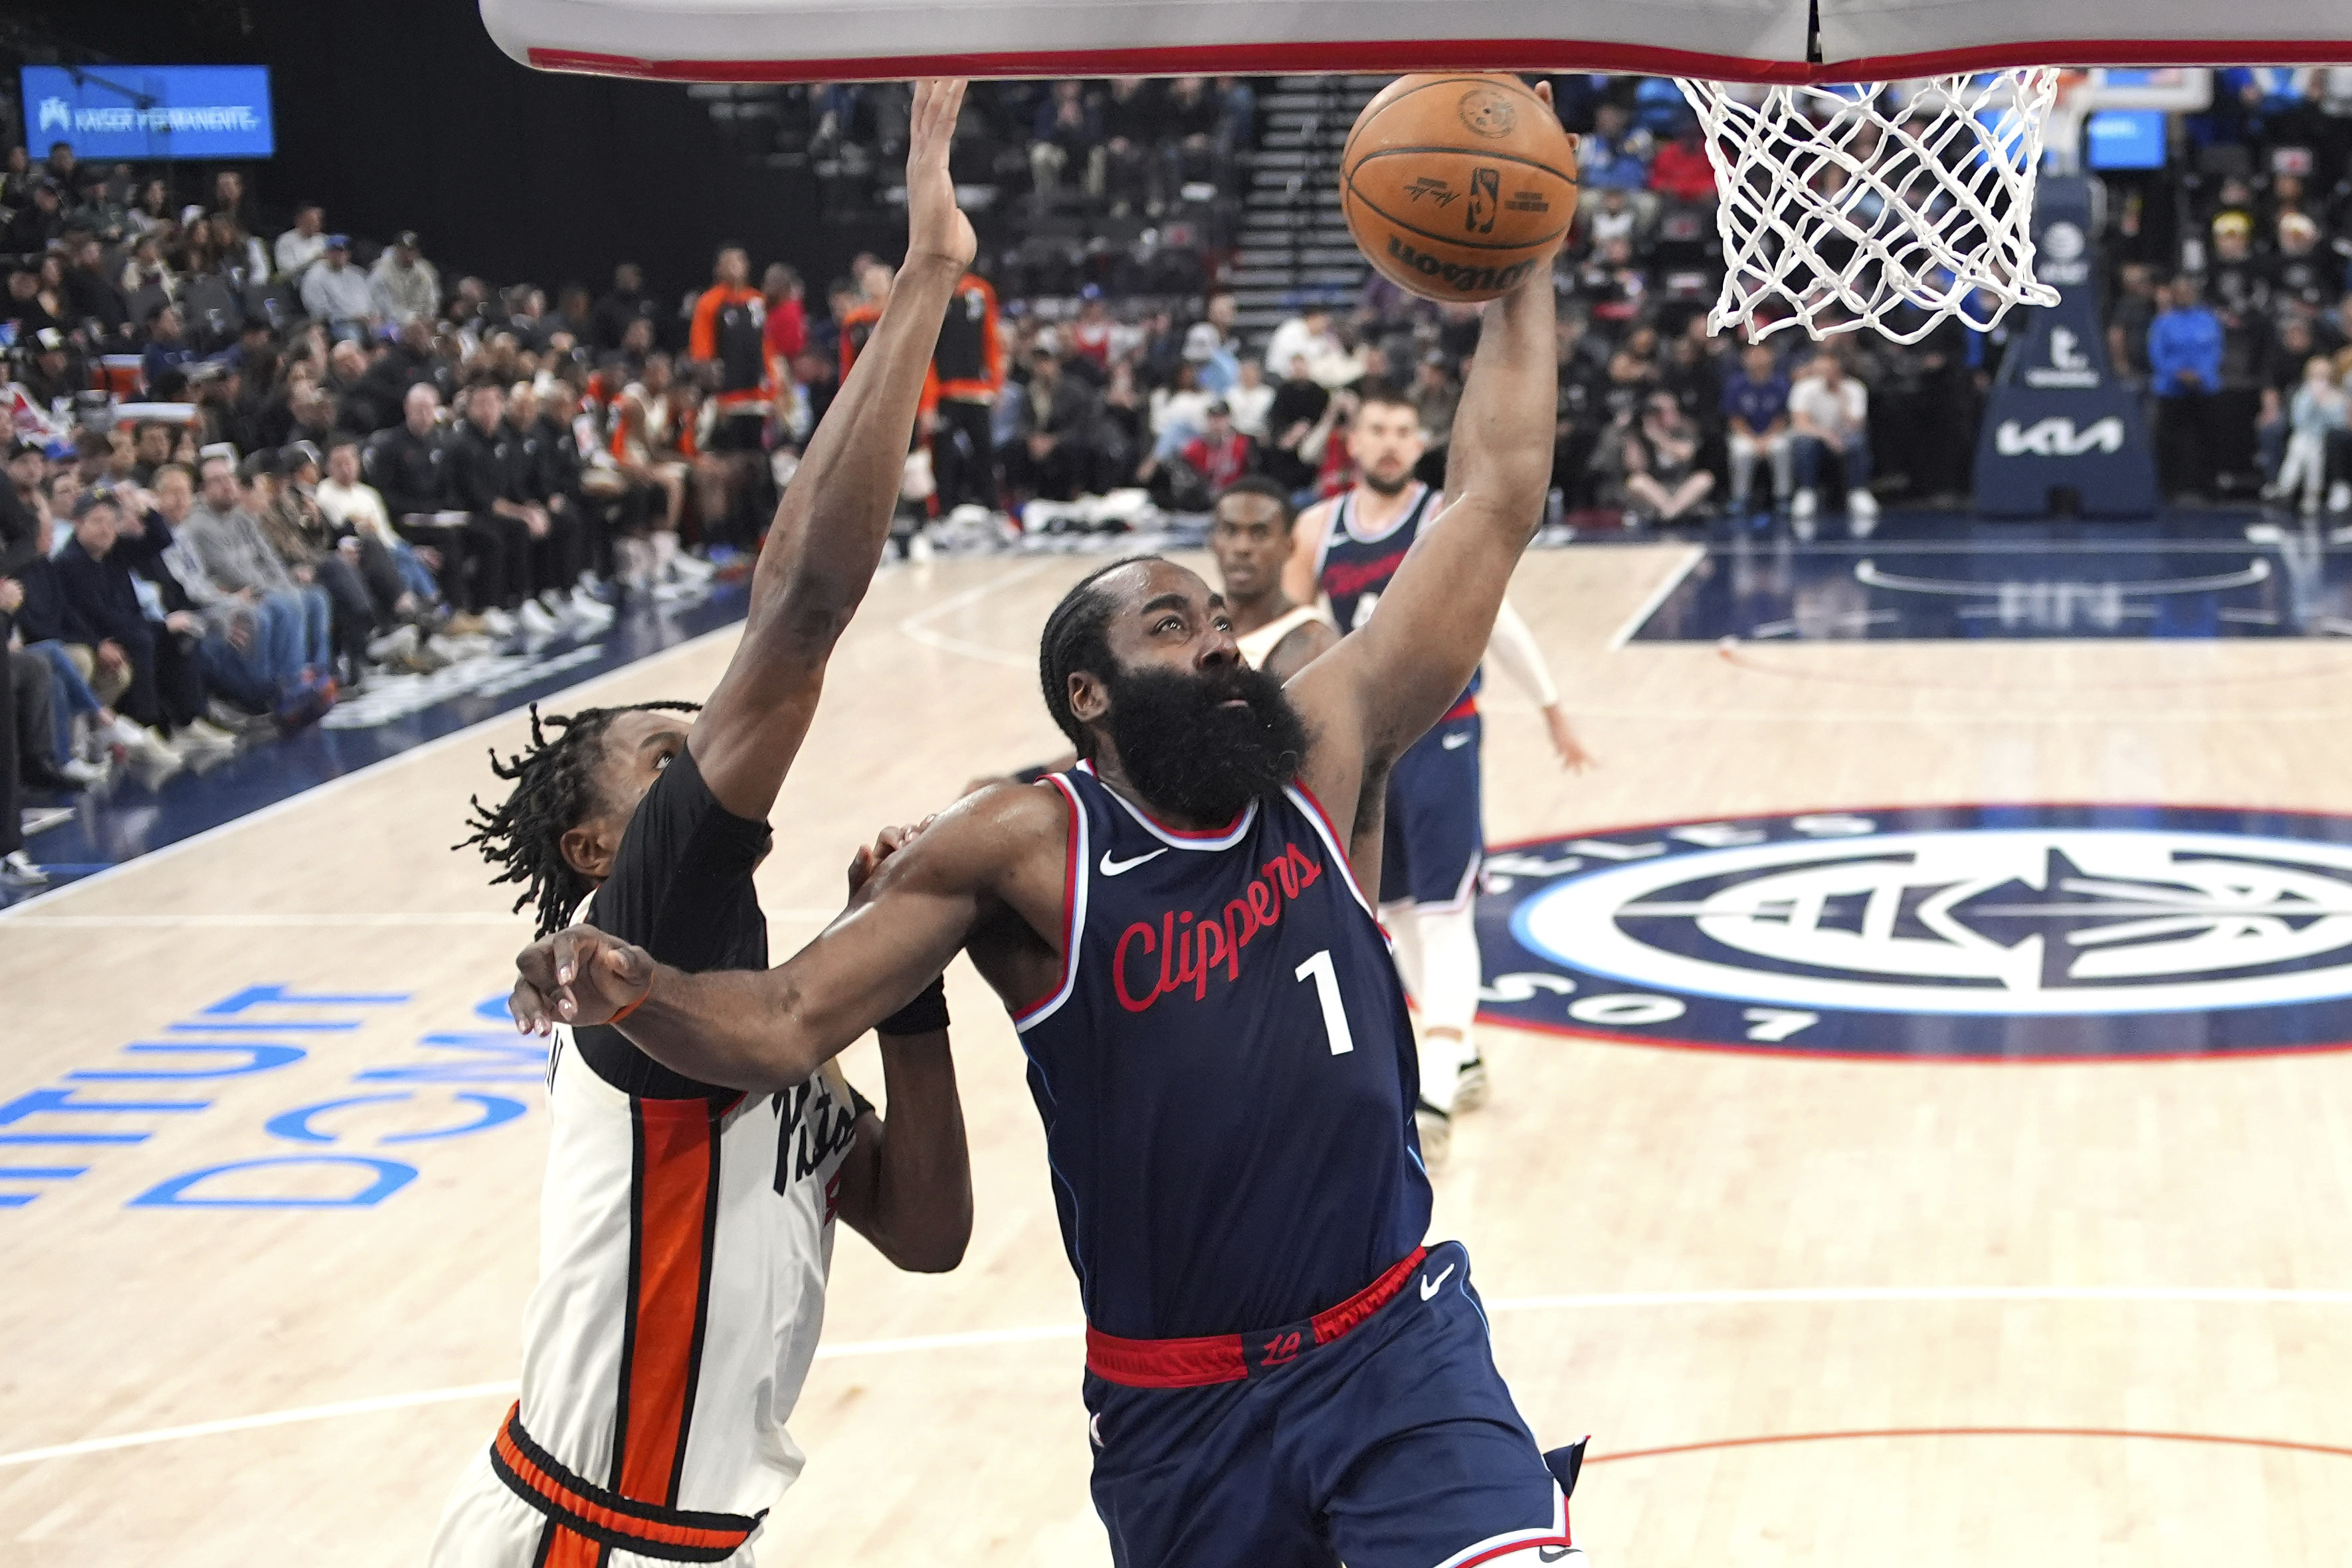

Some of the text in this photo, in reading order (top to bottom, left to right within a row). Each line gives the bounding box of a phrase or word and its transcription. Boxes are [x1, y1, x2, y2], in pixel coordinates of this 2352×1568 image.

[1113, 842, 1322, 1012] Clippers
[1295, 949, 1353, 1056] 1
[1260, 1331, 1301, 1366] LA
